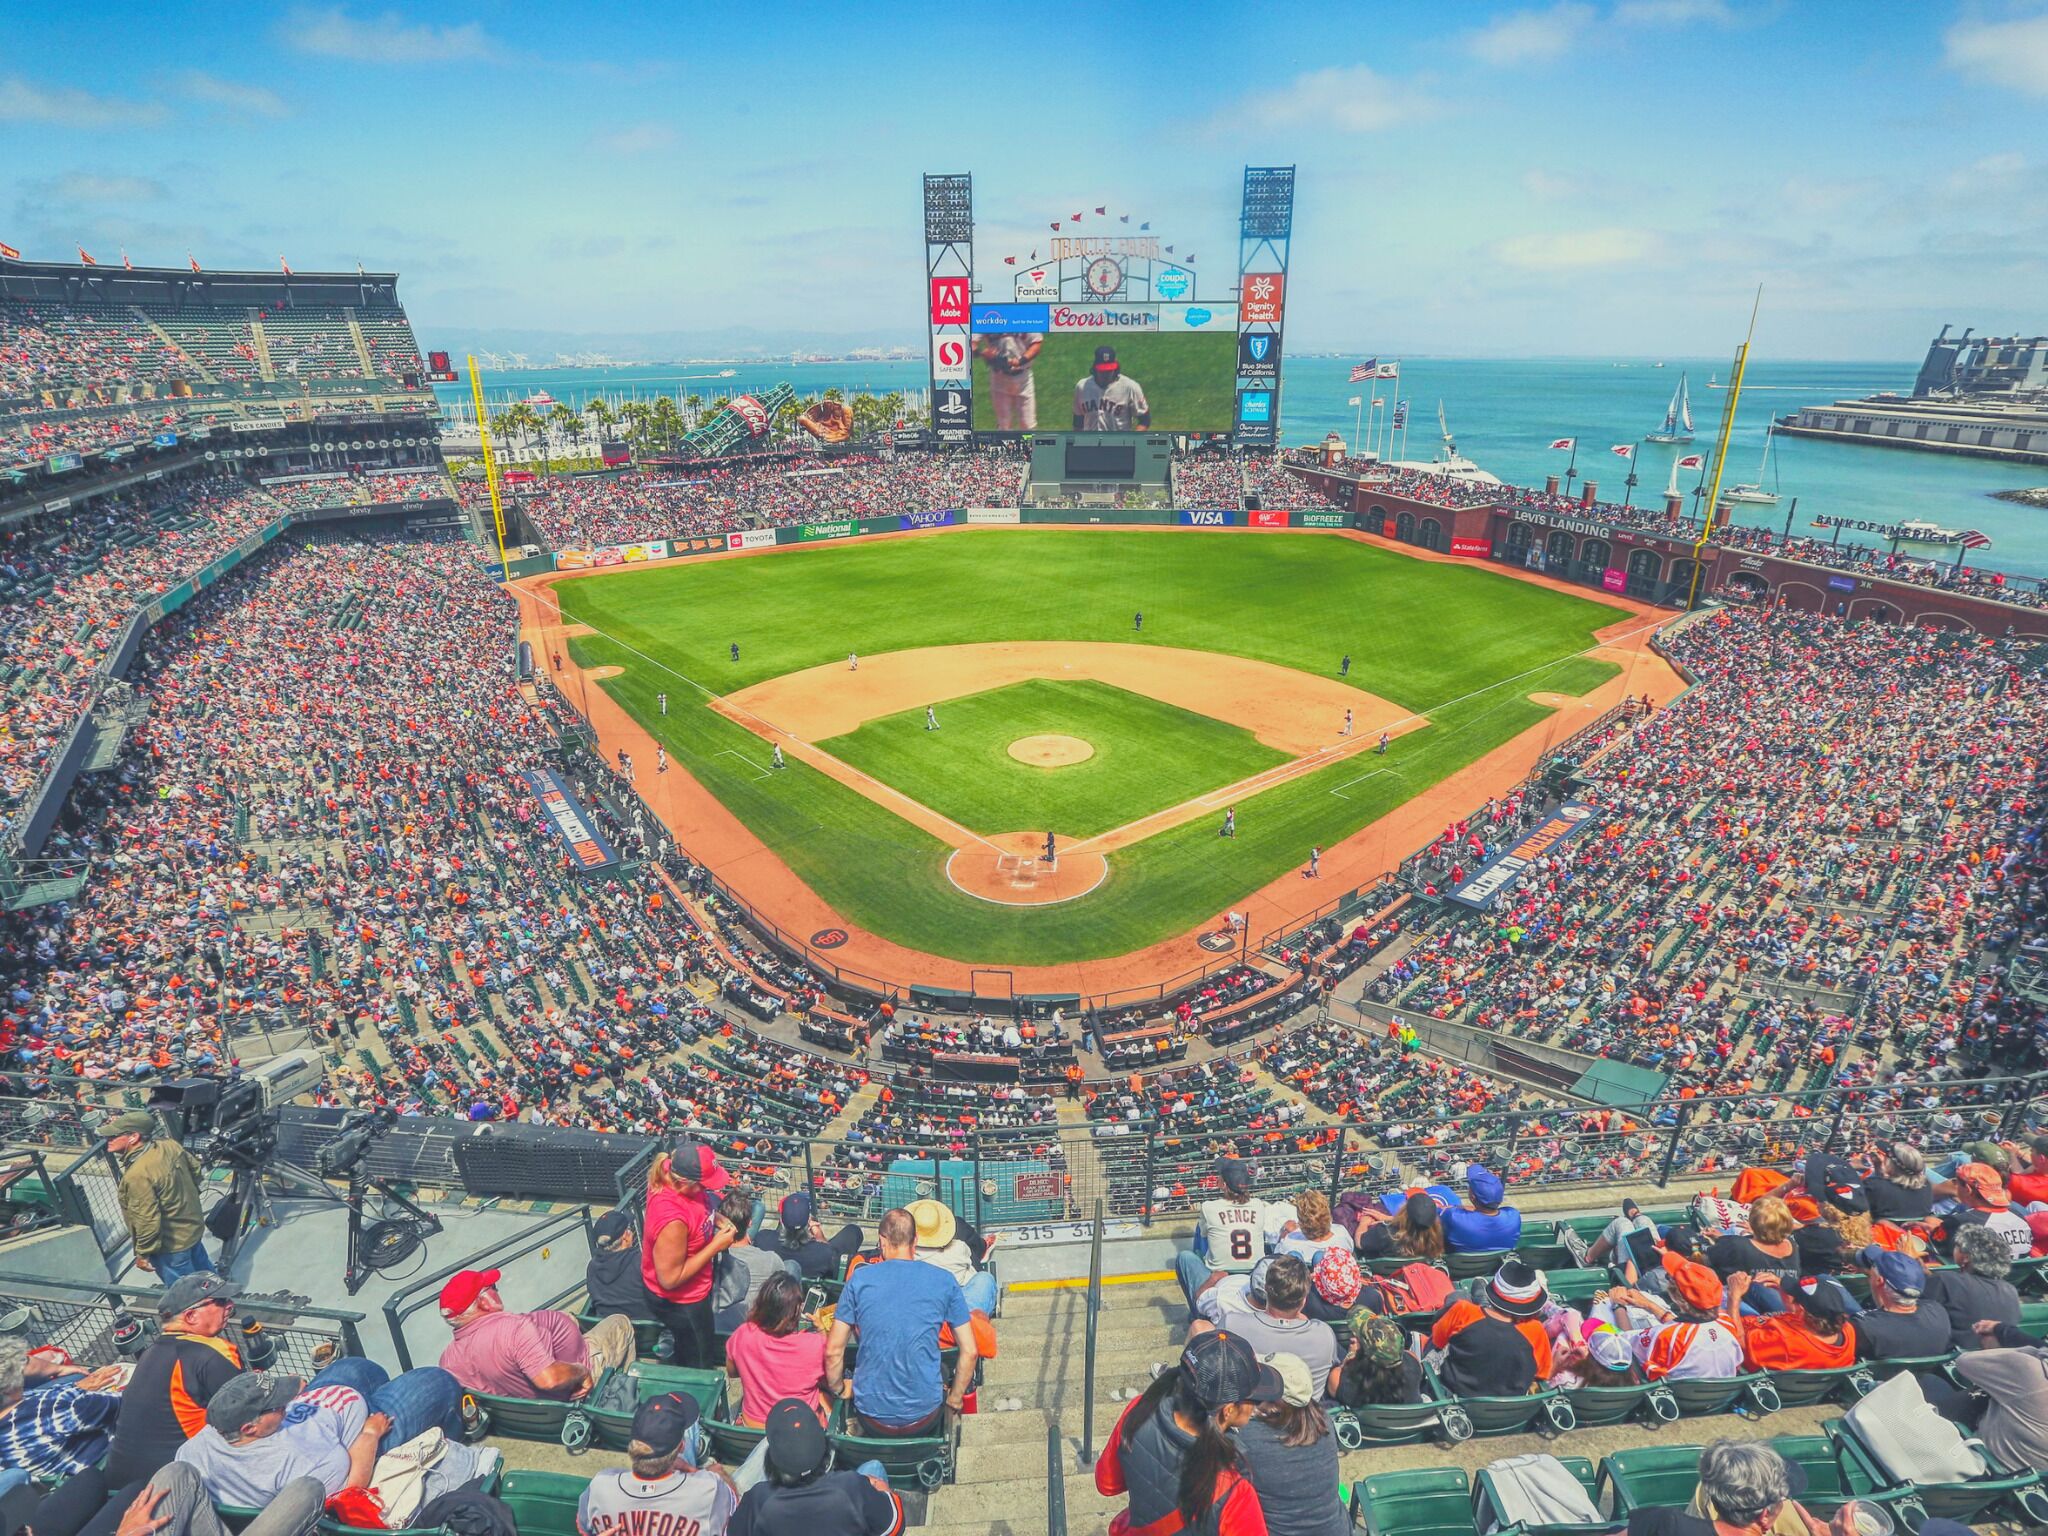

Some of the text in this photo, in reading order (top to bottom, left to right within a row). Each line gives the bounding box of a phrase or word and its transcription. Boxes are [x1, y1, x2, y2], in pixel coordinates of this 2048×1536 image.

[1051, 236, 1160, 261] ORACLE PARK
[1017, 286, 1058, 297] Fanatics
[940, 309, 961, 318] Adobe
[1247, 302, 1275, 313] Dignity
[975, 317, 1008, 326] workday
[1054, 306, 1150, 327] Coors LIGHT
[1247, 311, 1274, 320] Health
[255, 421, 283, 430] CANDIES
[493, 443, 602, 465] nuveen
[349, 506, 371, 516] xfinity
[402, 502, 424, 512] xfinity
[908, 512, 945, 524] YAHOO!
[1187, 511, 1223, 525] VISA
[815, 522, 852, 536] National
[1550, 517, 1609, 539] LANDING
[1816, 514, 1949, 545] BANK OF AMERICA
[745, 534, 774, 543] TOYOTA
[1456, 818, 1576, 902] WELCOME TO ORACLE PARK
[1218, 1209, 1257, 1225] PENCE
[1018, 1225, 1054, 1241] 315
[1230, 1228, 1253, 1261] 8
[591, 1510, 701, 1536] CRAWFORD
